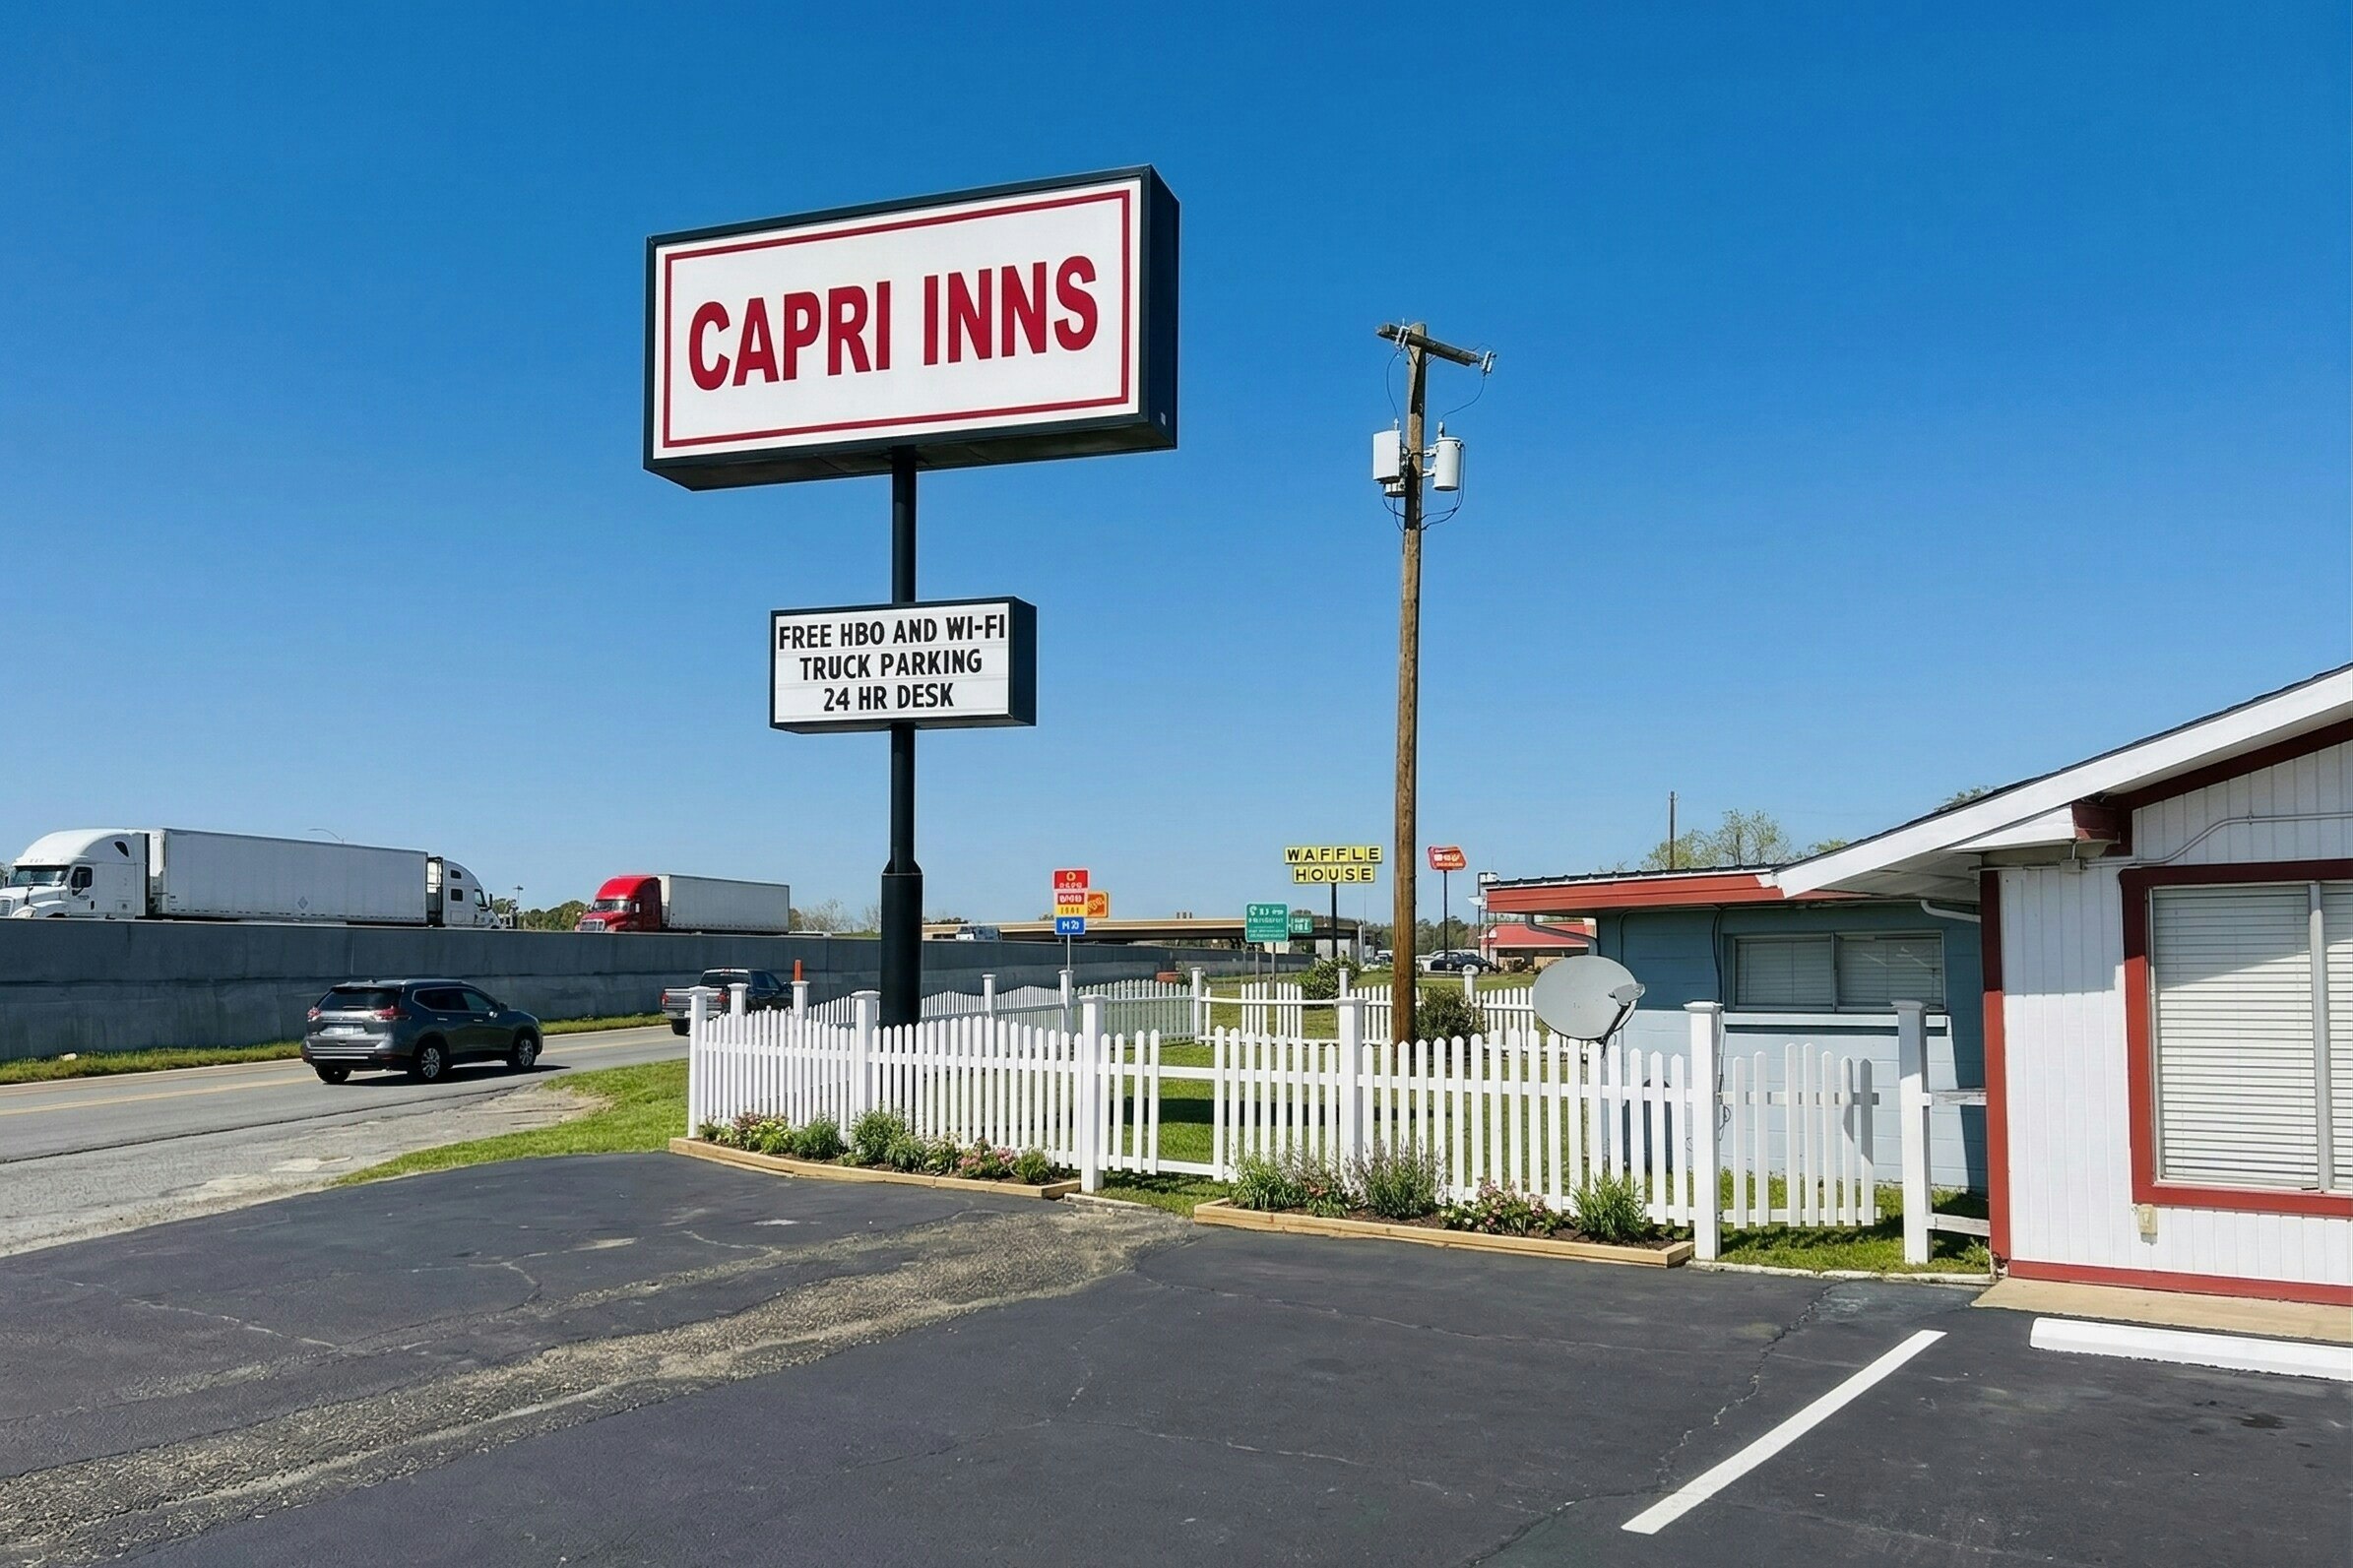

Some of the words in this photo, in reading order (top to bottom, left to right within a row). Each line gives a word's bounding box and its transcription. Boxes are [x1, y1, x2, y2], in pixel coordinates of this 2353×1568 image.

[689, 280, 891, 392] CAPRI
[923, 255, 1099, 366] INNS
[779, 624, 832, 650] FREE
[840, 621, 885, 647] HBO
[892, 617, 937, 644] AND
[946, 613, 1005, 641] WI-FI
[799, 654, 871, 680] TRUCK
[880, 649, 983, 676] PARKING
[823, 687, 850, 712] 24
[859, 685, 887, 710] HR
[897, 682, 954, 709] DESK
[1287, 847, 1379, 861] WAFFLE
[1296, 868, 1371, 881] HOUSE
